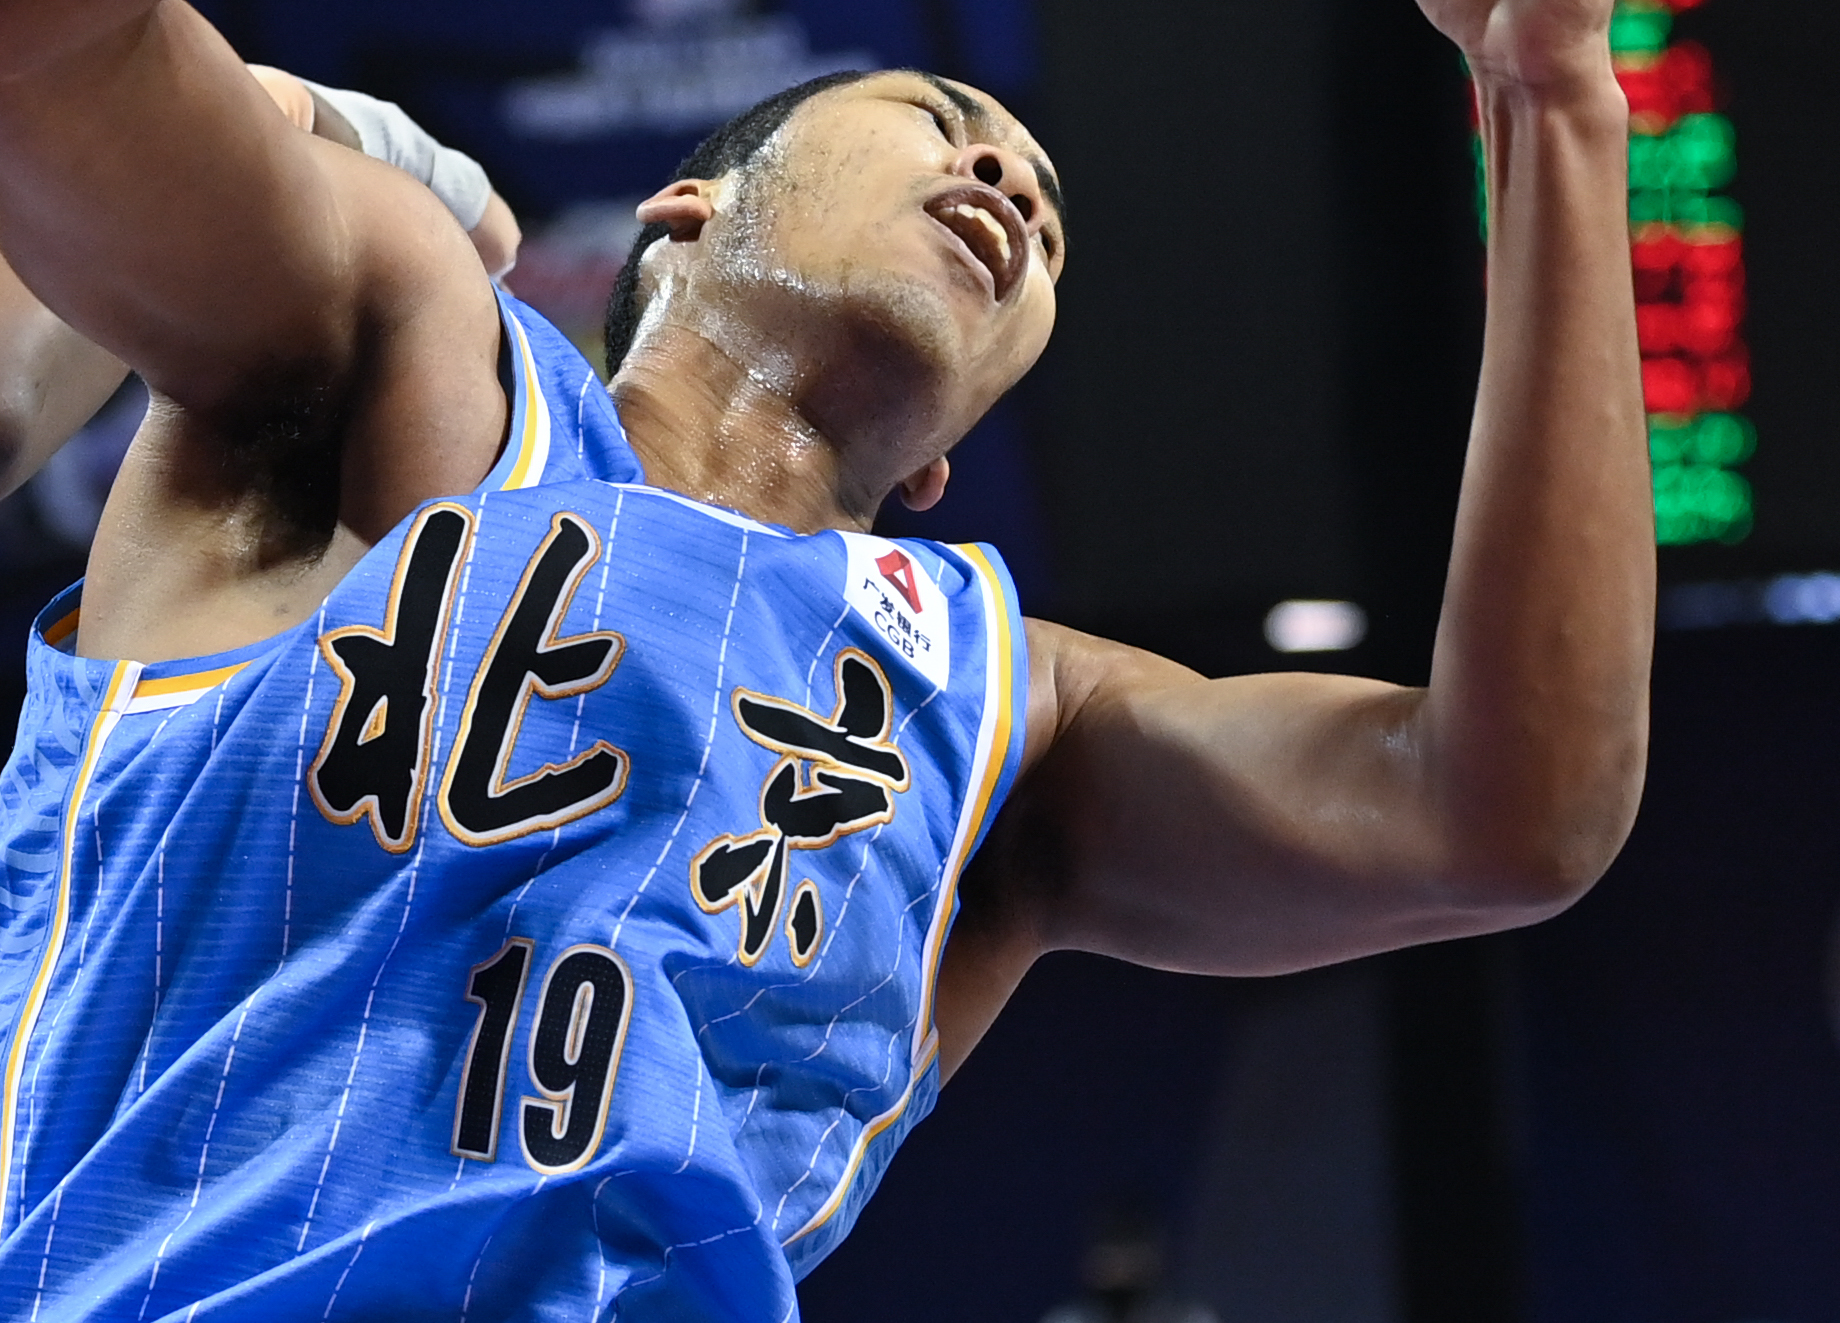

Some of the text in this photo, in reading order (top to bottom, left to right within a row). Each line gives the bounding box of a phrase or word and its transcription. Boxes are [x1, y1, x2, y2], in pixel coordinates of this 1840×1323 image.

[863, 577, 932, 653] 广发银行
[874, 611, 915, 659] CGB
[308, 501, 911, 968] 北京
[450, 936, 635, 1176] 19
